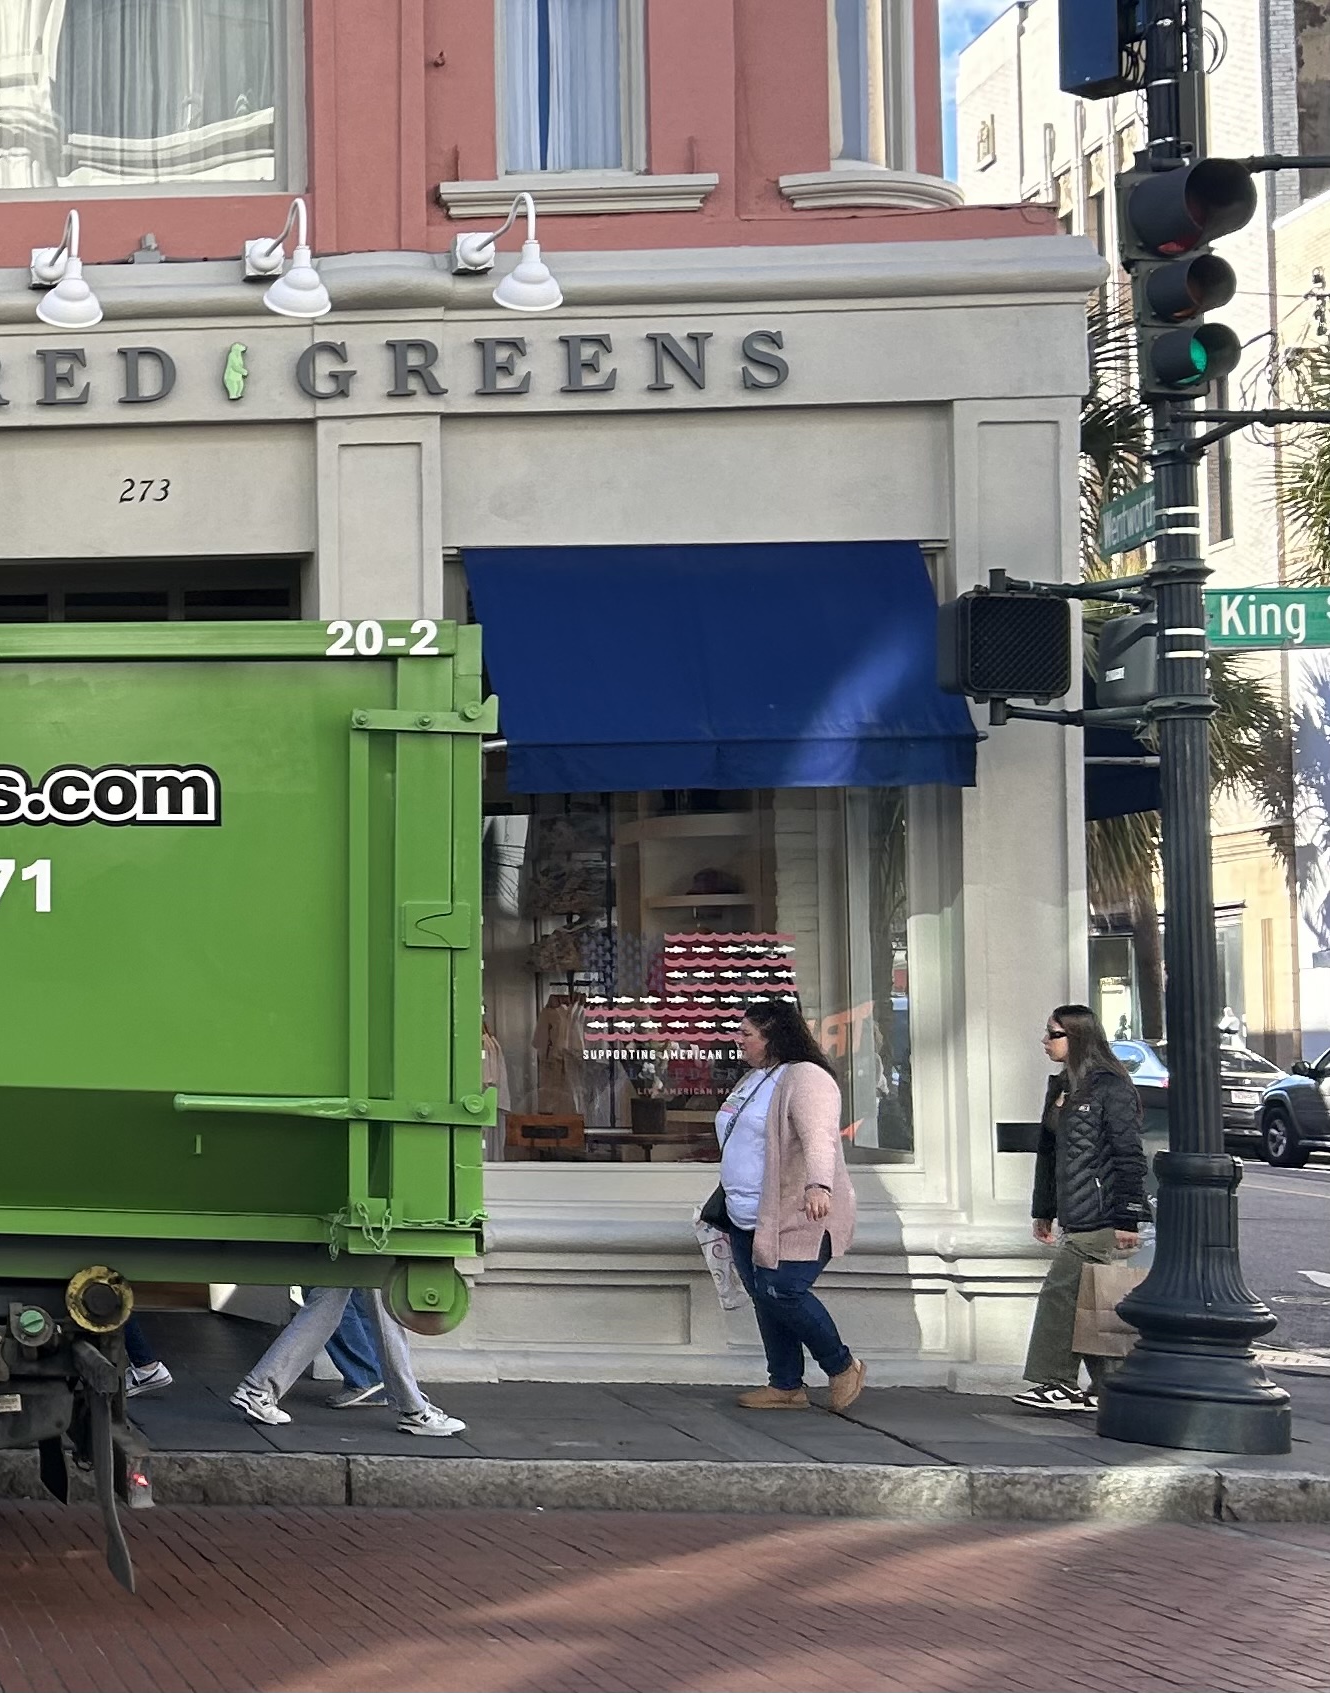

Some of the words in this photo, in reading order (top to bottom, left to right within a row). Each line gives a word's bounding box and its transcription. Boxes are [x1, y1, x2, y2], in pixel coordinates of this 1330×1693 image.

[296, 330, 789, 399] GREENS
[119, 478, 171, 503] 273
[1221, 594, 1306, 643] King
[325, 619, 439, 656] 20-2
[583, 1049, 657, 1060] SUPPORTING
[662, 1049, 723, 1060] AMERICAN
